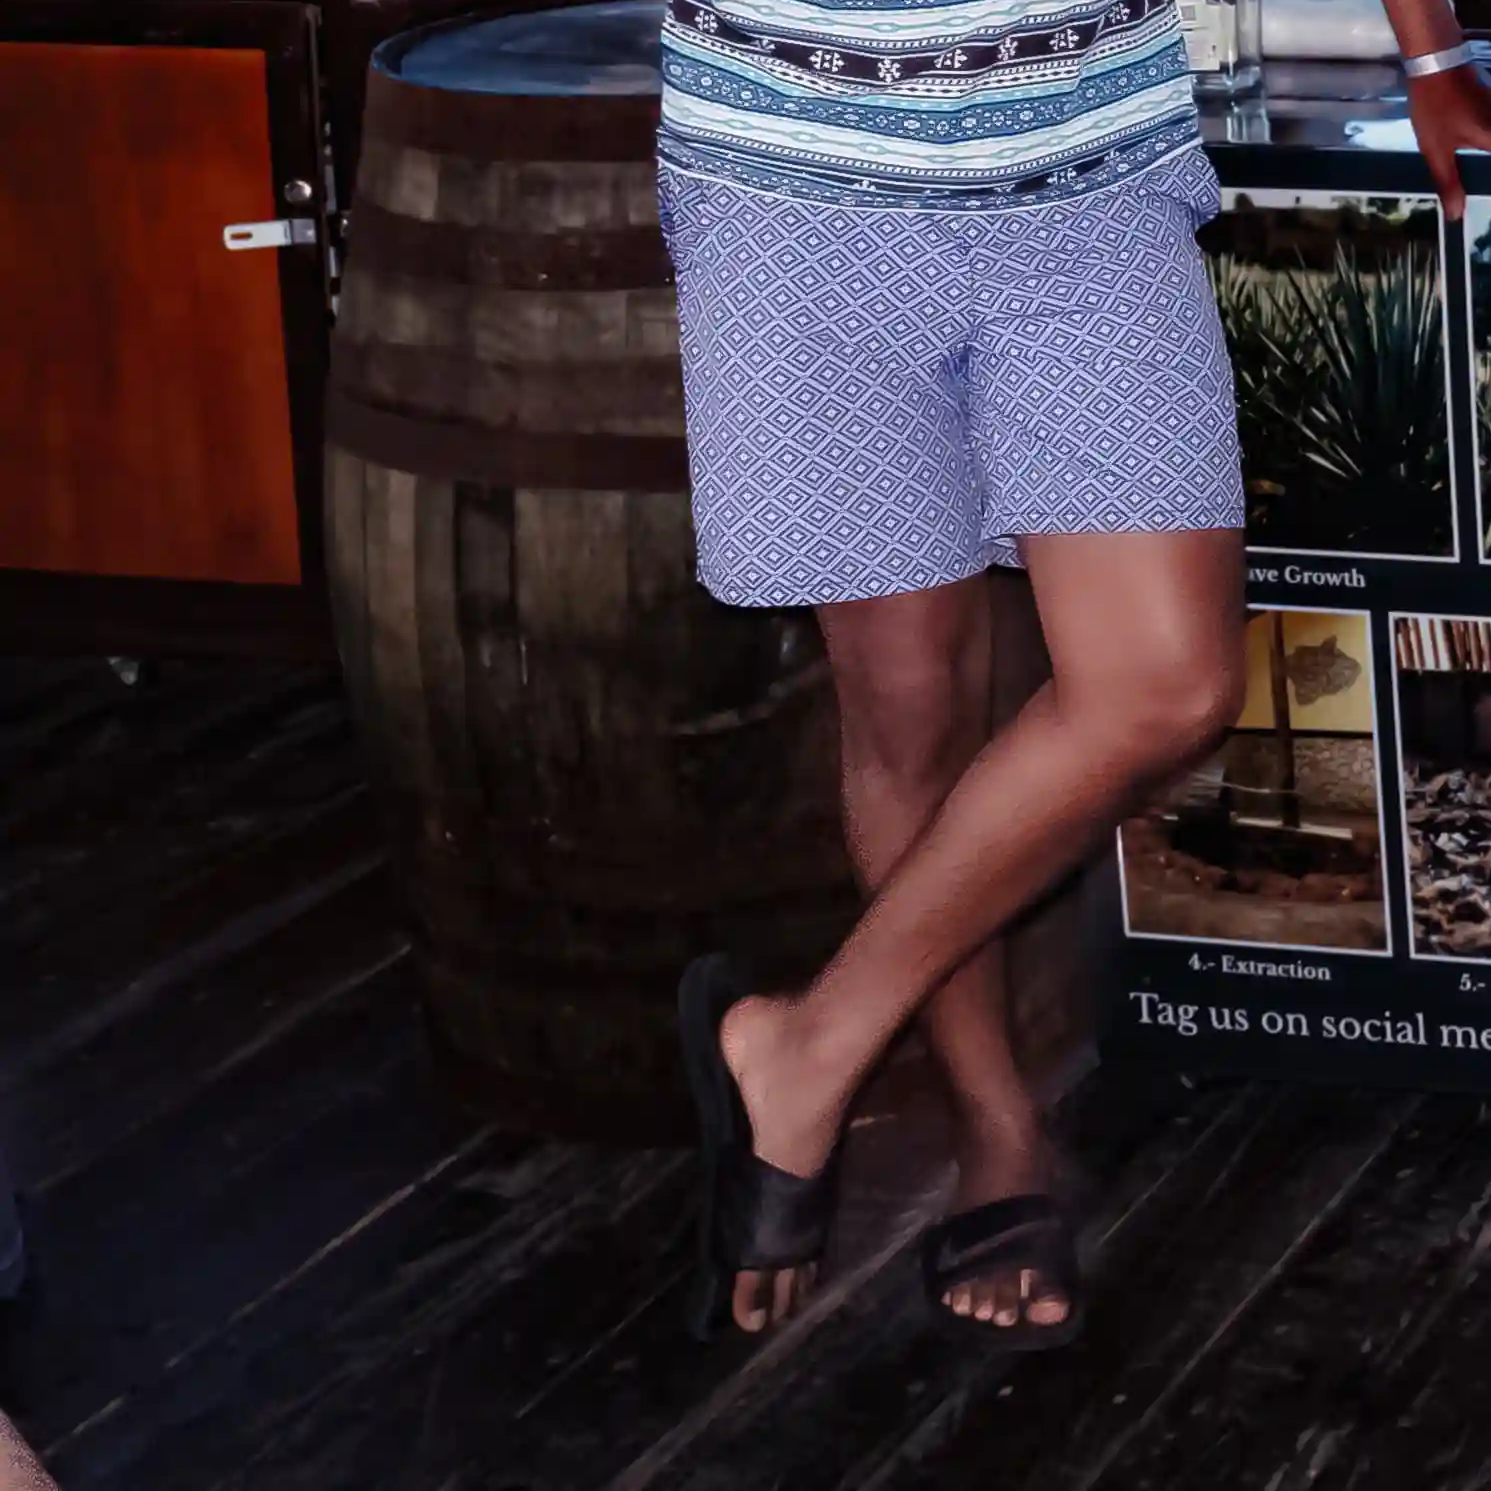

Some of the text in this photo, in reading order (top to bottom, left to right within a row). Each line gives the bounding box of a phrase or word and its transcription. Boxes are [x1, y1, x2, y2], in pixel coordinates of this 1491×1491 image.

[1284, 565, 1367, 588] Growth
[1221, 954, 1332, 981] Extraction
[1129, 991, 1199, 1036] Tag
[1208, 1006, 1249, 1031] us
[1261, 1011, 1310, 1036] on
[1322, 1011, 1428, 1045] social
